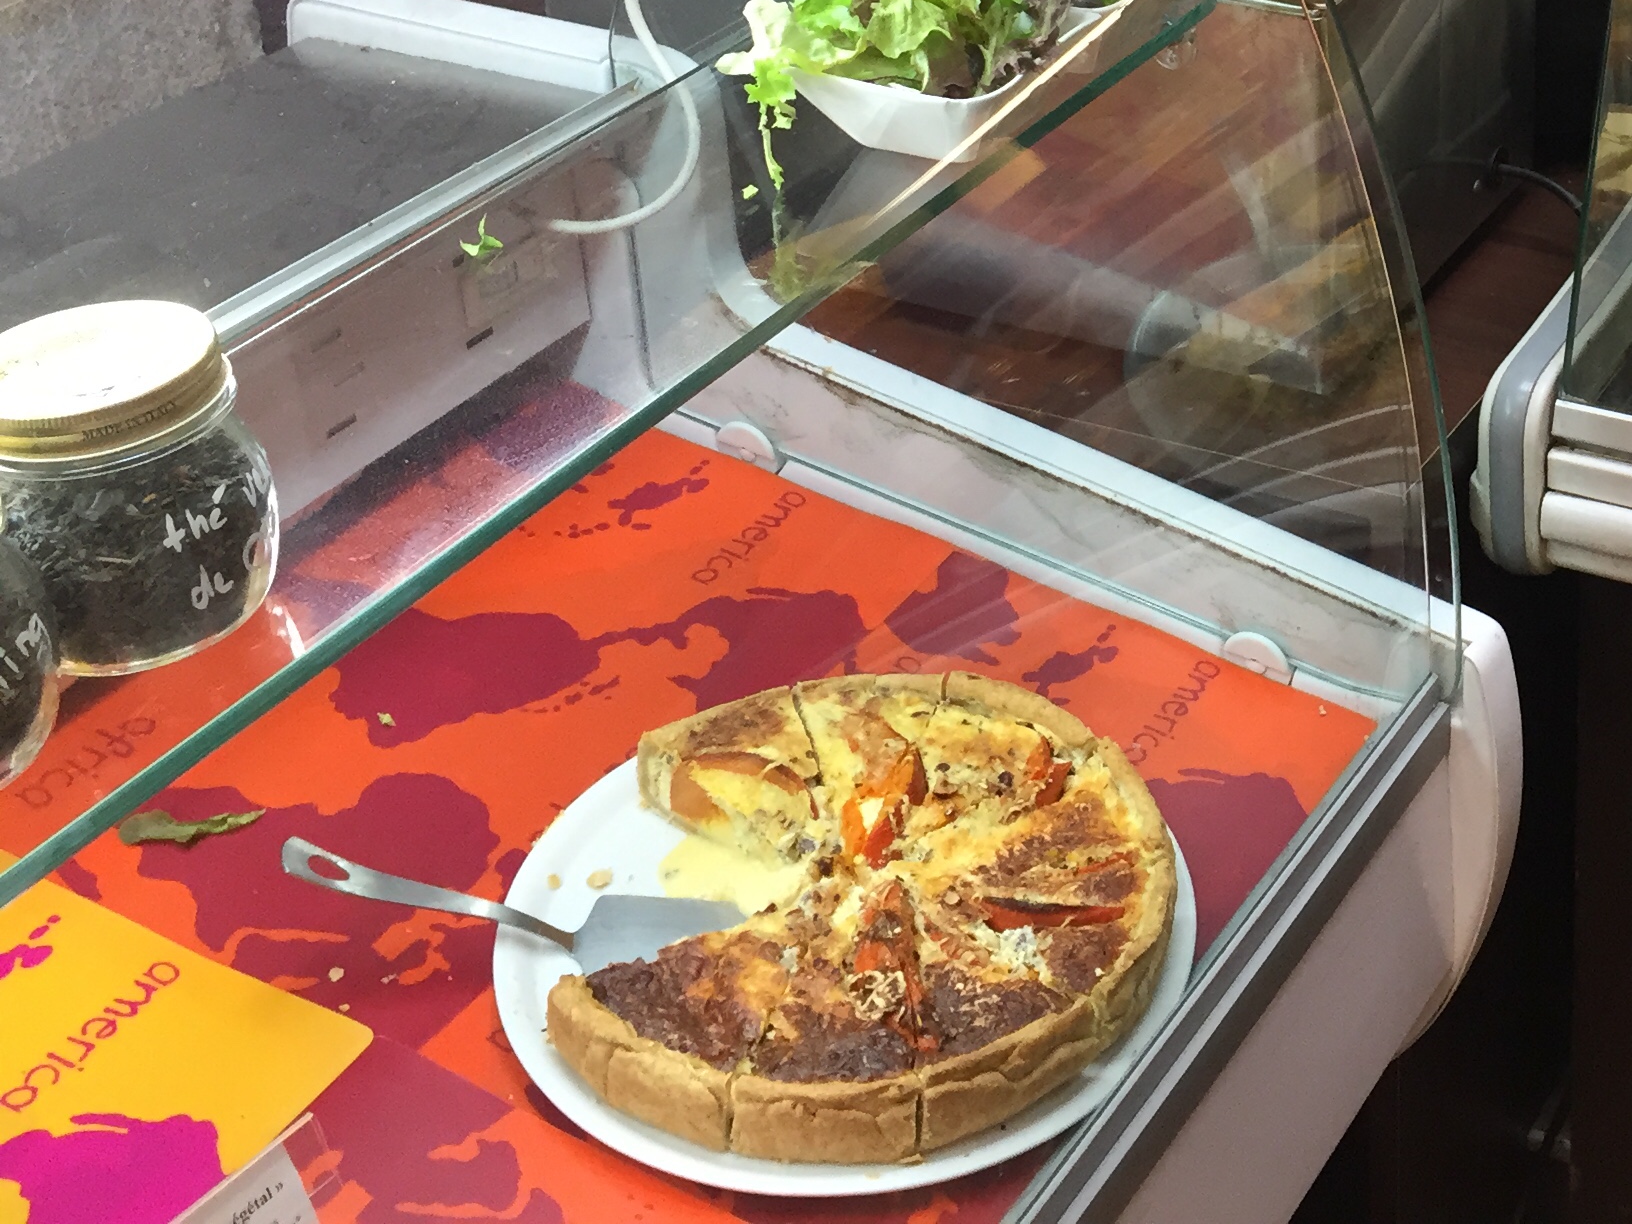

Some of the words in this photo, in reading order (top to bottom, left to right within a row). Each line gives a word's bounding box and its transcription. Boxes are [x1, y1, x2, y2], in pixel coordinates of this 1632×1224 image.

[162, 482, 230, 554] thé
[190, 563, 235, 612] de
[0, 960, 182, 1112] america
